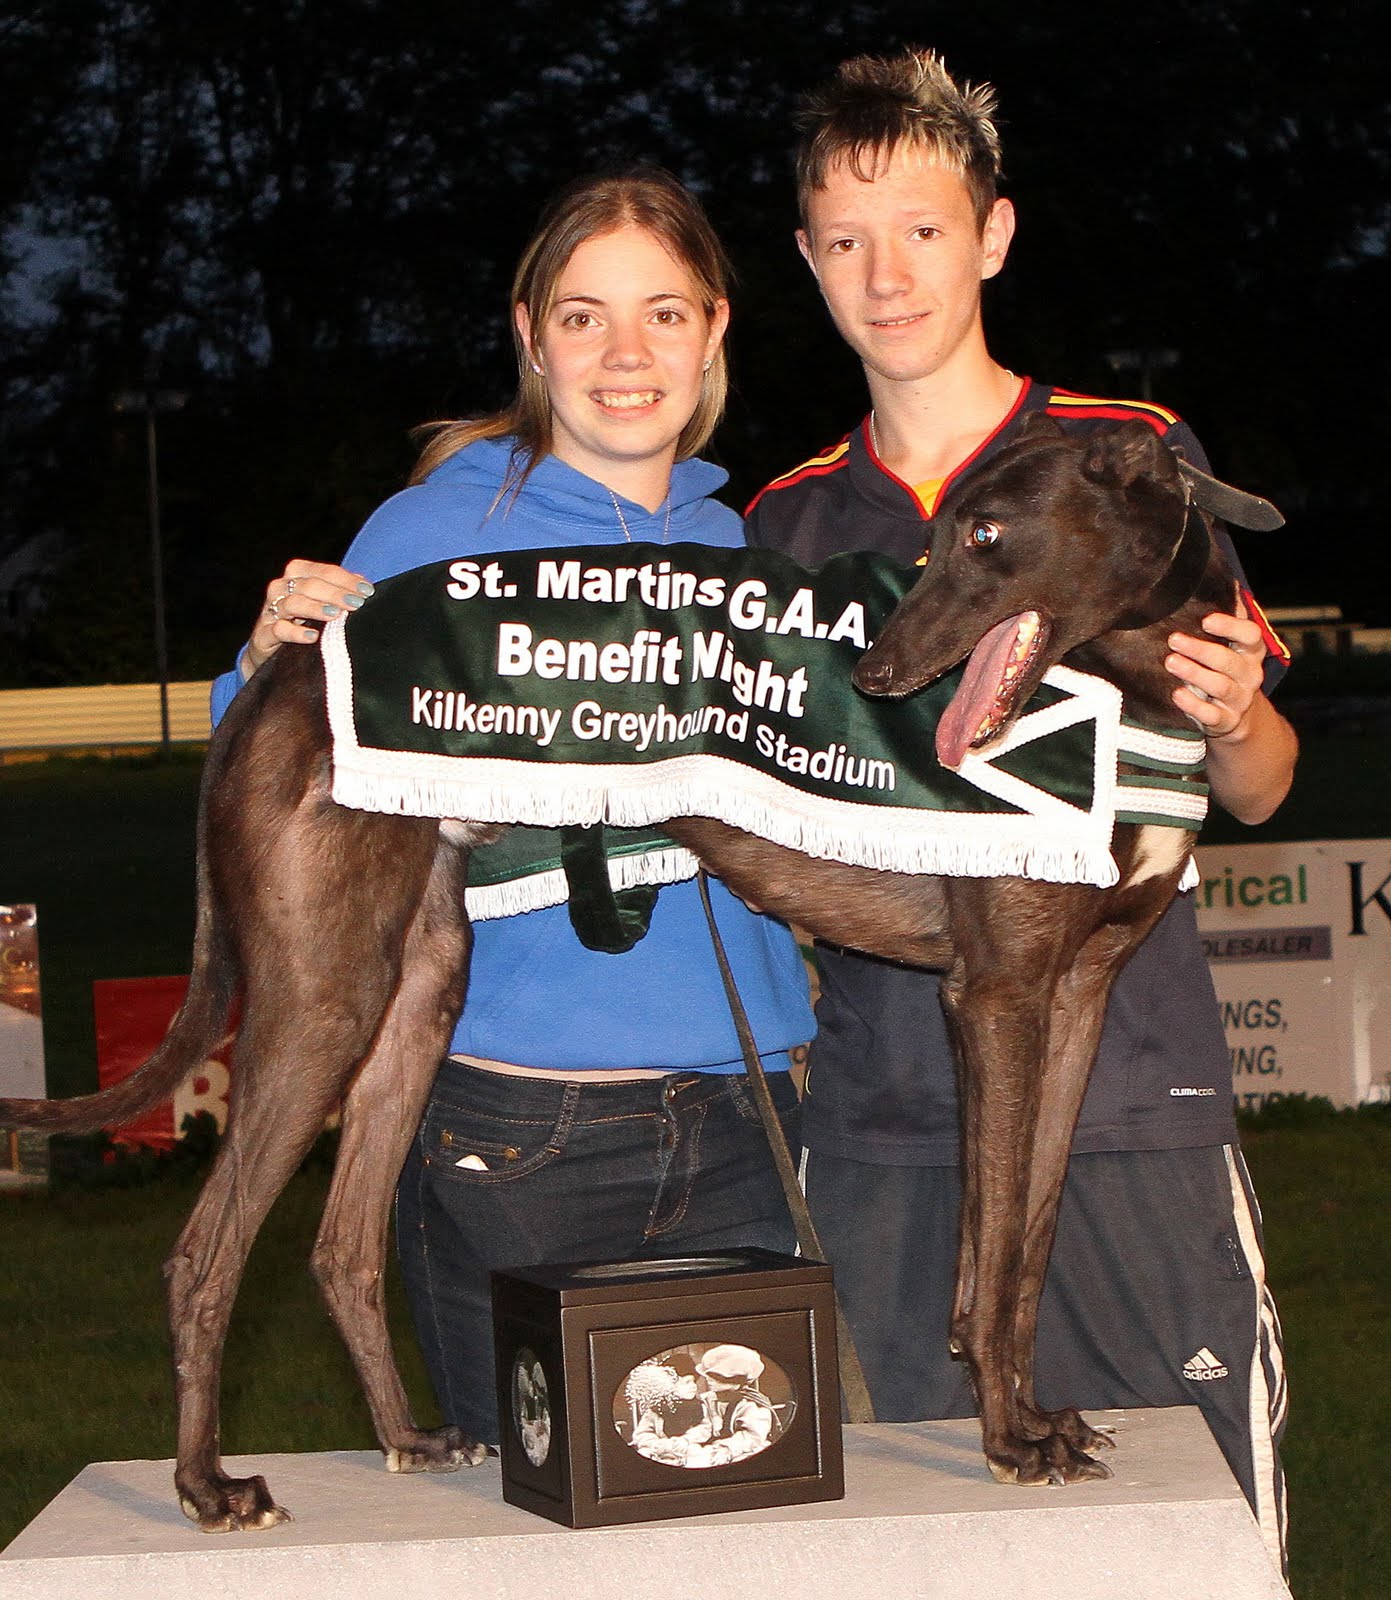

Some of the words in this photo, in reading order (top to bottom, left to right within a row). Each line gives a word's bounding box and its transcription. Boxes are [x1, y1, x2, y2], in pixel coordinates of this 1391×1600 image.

[446, 561, 518, 600] St.
[536, 560, 726, 610] Martins
[497, 621, 683, 685] Benefit
[691, 631, 809, 718] Night
[412, 686, 562, 747] Kilkenny
[571, 699, 749, 750] Greyhound
[755, 724, 896, 791] Stadium
[1195, 864, 1309, 910] rical
[1182, 1366, 1229, 1381] adidas
